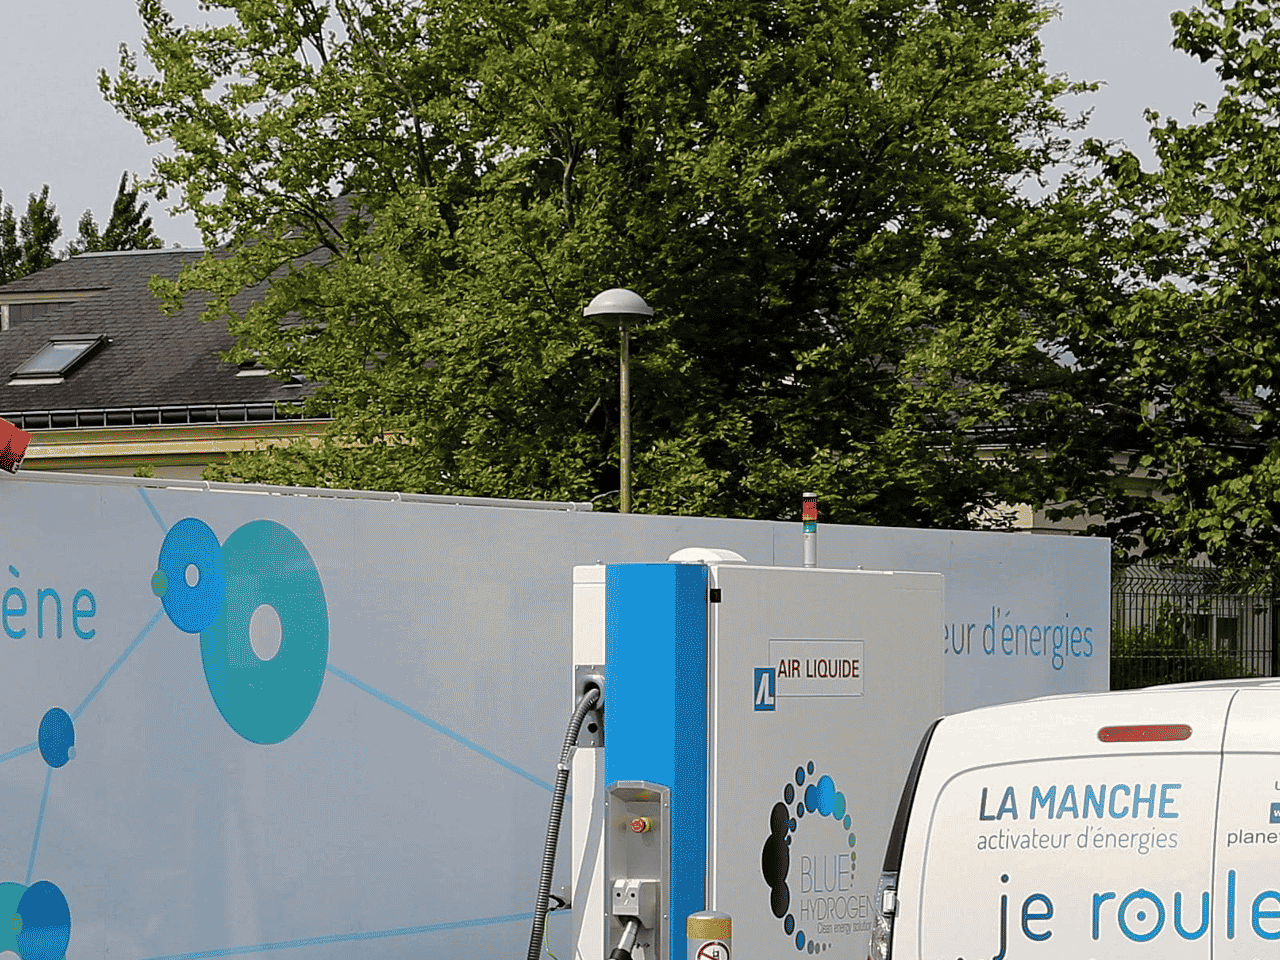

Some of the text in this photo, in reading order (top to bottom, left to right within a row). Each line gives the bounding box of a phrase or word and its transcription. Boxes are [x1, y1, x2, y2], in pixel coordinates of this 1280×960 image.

[982, 605, 1093, 671] d'énergies
[777, 659, 860, 679] AIR LIQUIDE
[979, 783, 1182, 821] LA MANCHE
[977, 825, 1178, 855] activateur d'énergies
[800, 853, 850, 894] BLUE
